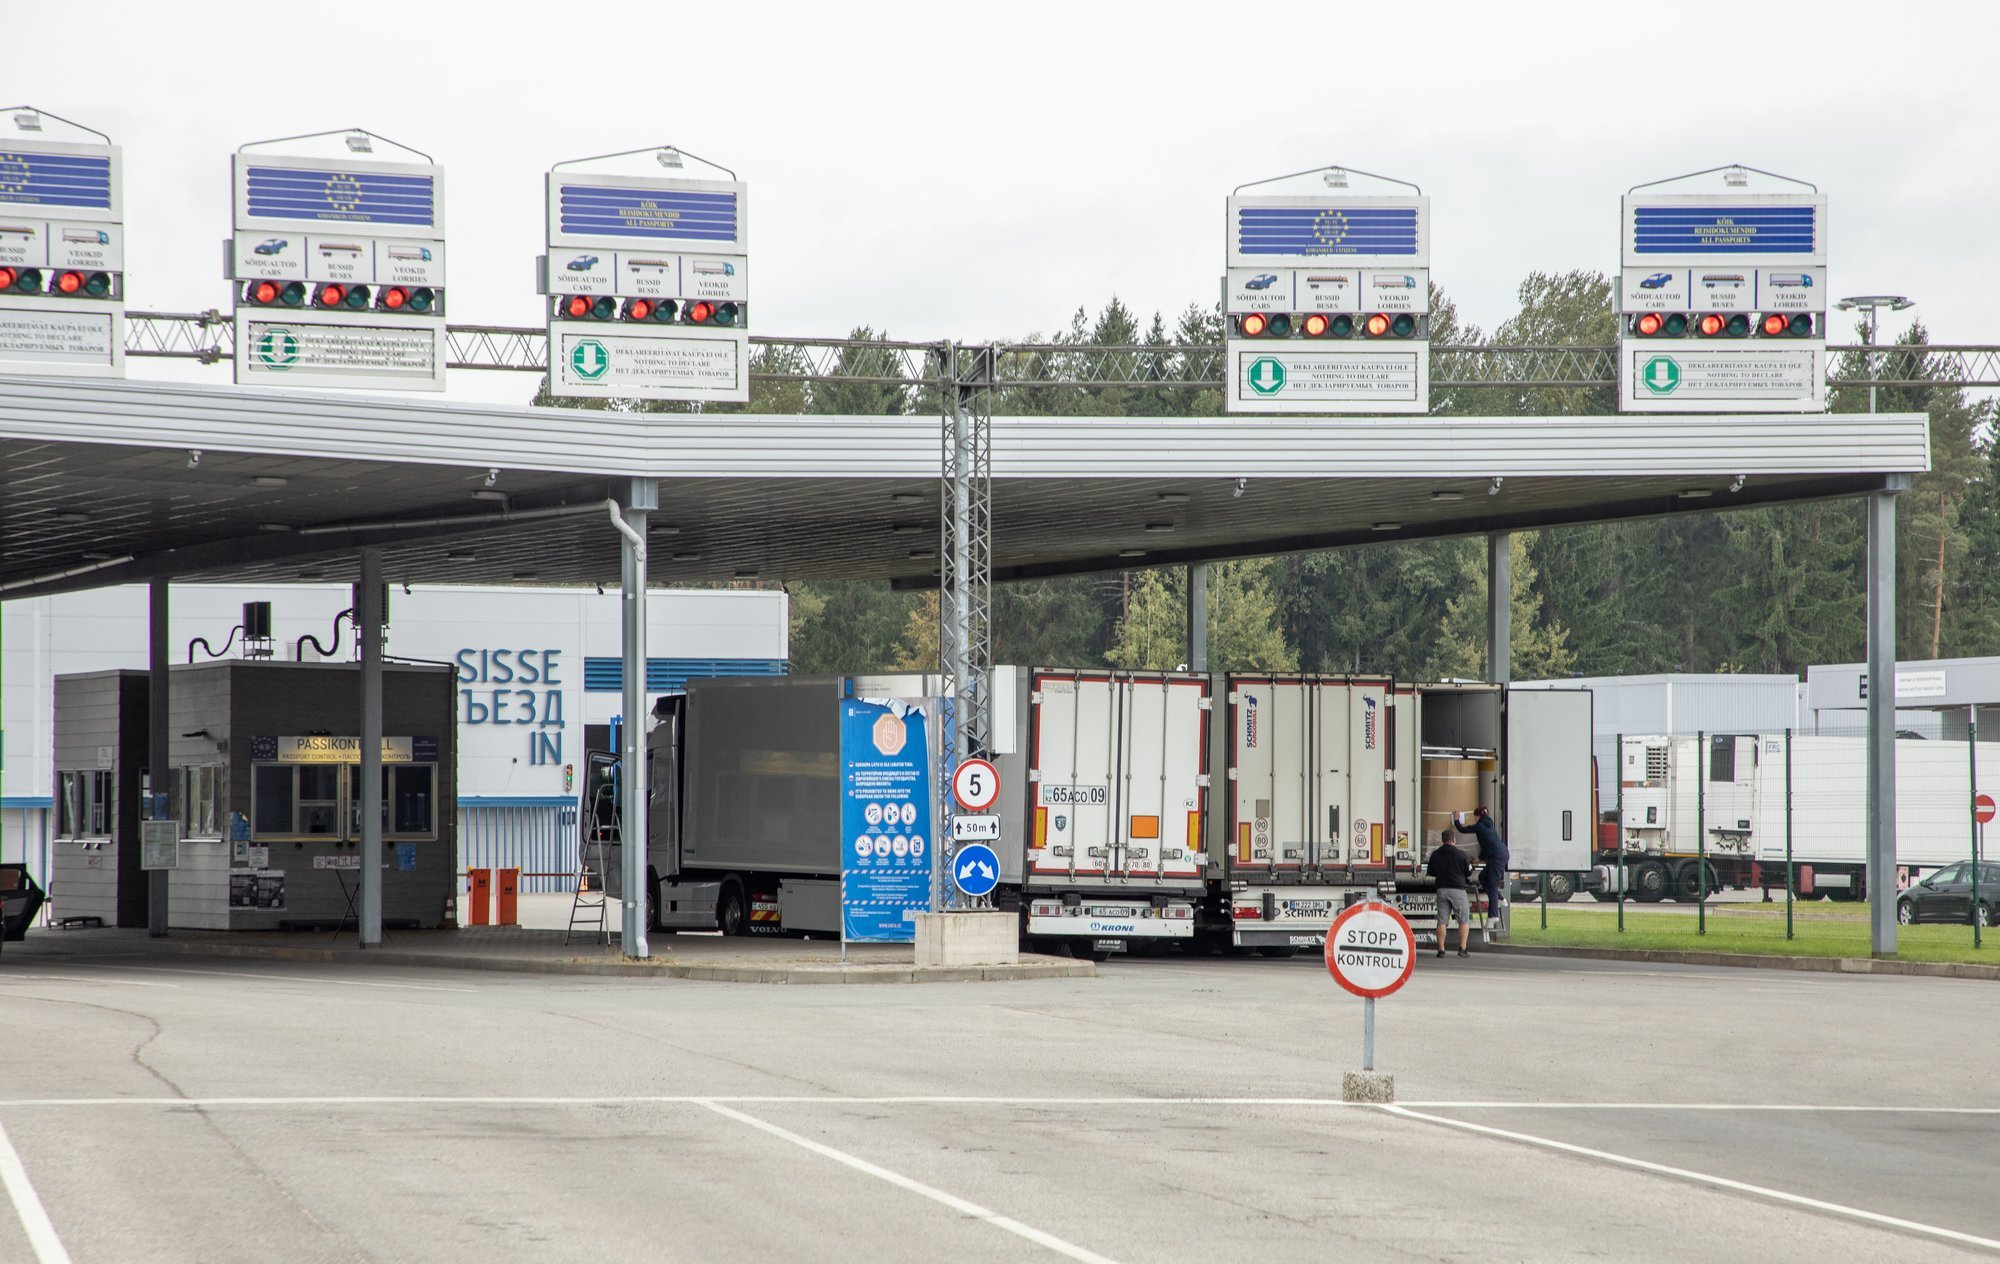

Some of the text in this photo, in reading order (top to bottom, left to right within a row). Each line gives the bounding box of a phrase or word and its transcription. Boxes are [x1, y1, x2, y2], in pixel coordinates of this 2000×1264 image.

[640, 200, 658, 208] KÕIK
[619, 210, 680, 219] REISIDOKUMENDID
[639, 220, 674, 228] PASSPORTS
[1716, 217, 1734, 225] KÕIK
[244, 257, 297, 268] SÕIDUAUTOD
[328, 263, 354, 272] BUSSID
[394, 266, 425, 274] VEOKID
[392, 274, 427, 283] LORRIES
[558, 274, 607, 283] SÕIDUAUTOD
[573, 284, 592, 292] CARS
[638, 286, 660, 294] BUSES
[698, 289, 730, 297] LORRIES
[1236, 293, 1286, 301] SÕIDUAUTOD
[1630, 292, 1680, 300] SÕIDUAUTOD
[457, 648, 562, 684] SISSE
[460, 689, 565, 728] ЪЕЗД
[297, 738, 393, 750] PASSIKONTL
[530, 732, 562, 765] IN
[970, 773, 981, 796] 5
[1091, 788, 1105, 802] 09
[1285, 910, 1329, 918] SCHMITZ
[1348, 930, 1397, 946] STOPP
[1337, 954, 1404, 969] KONTROLL
